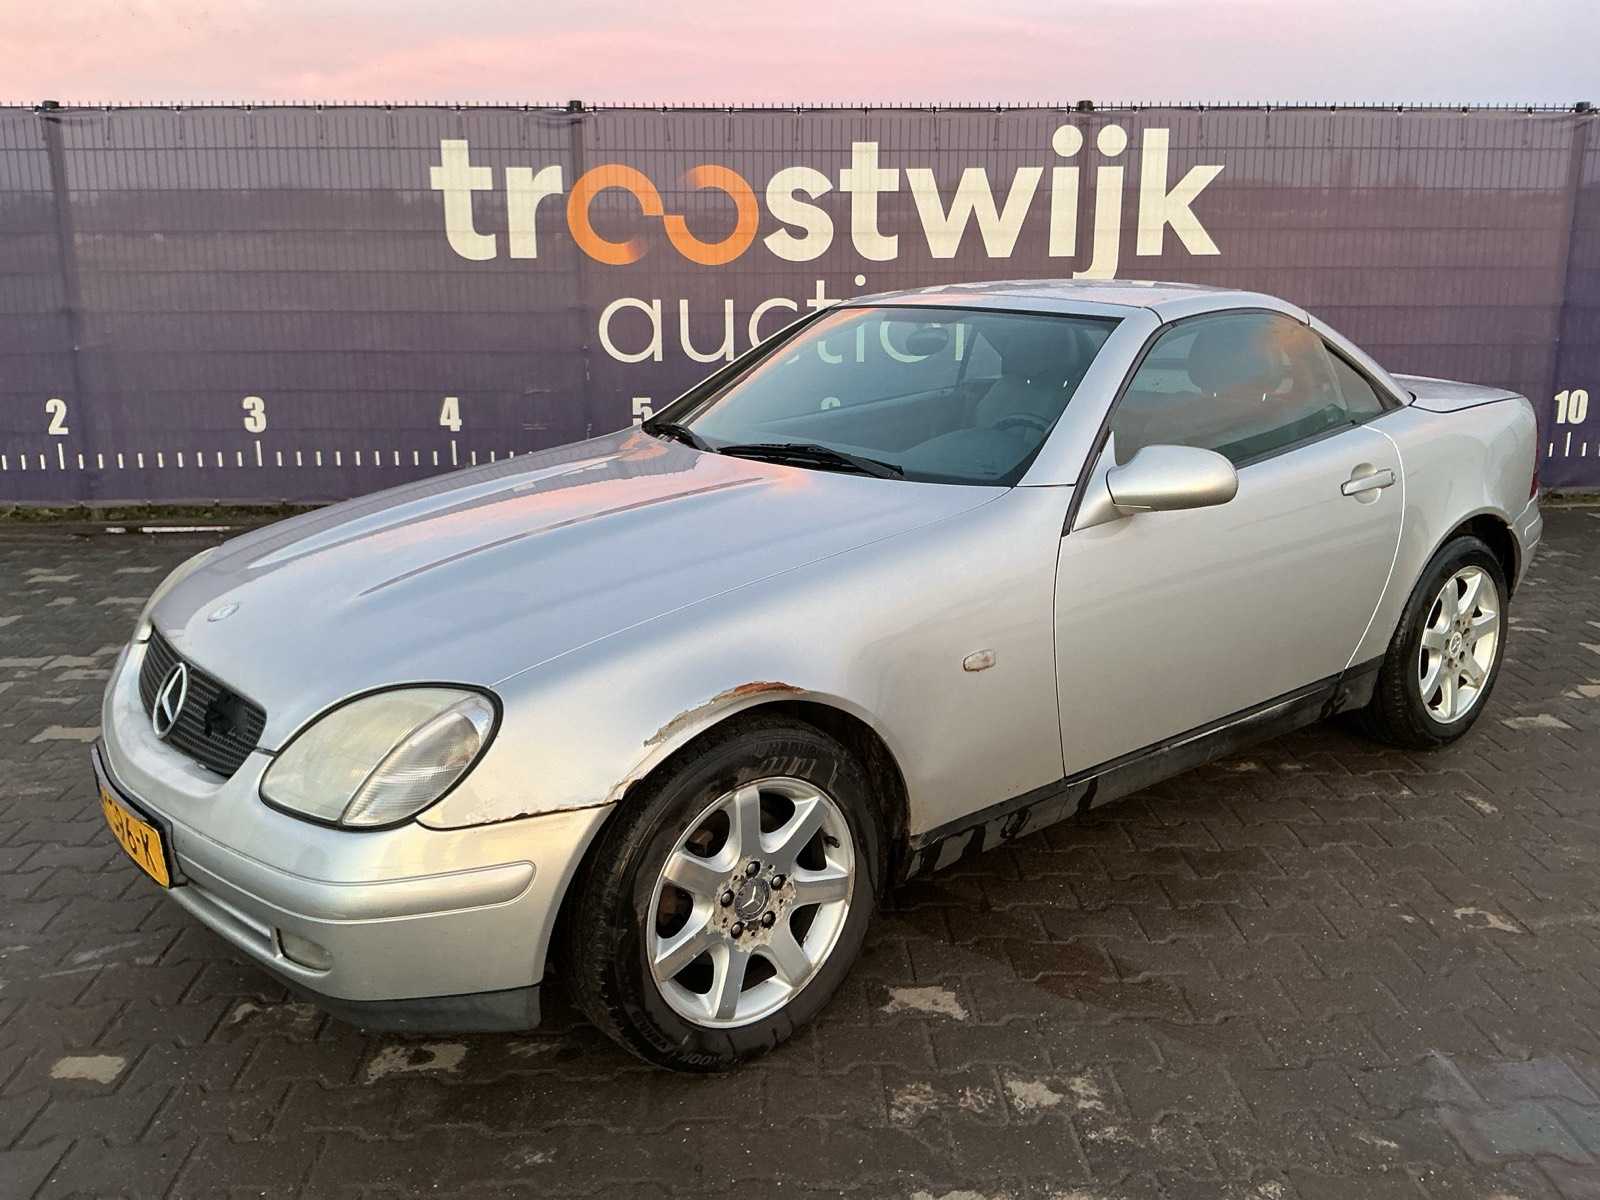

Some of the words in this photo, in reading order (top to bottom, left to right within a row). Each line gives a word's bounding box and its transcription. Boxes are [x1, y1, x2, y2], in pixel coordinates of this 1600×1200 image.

[429, 124, 1225, 280] troostwijk
[45, 398, 69, 435] 2
[242, 396, 267, 433] 3
[439, 397, 463, 432] 4
[1554, 389, 1588, 424] 10
